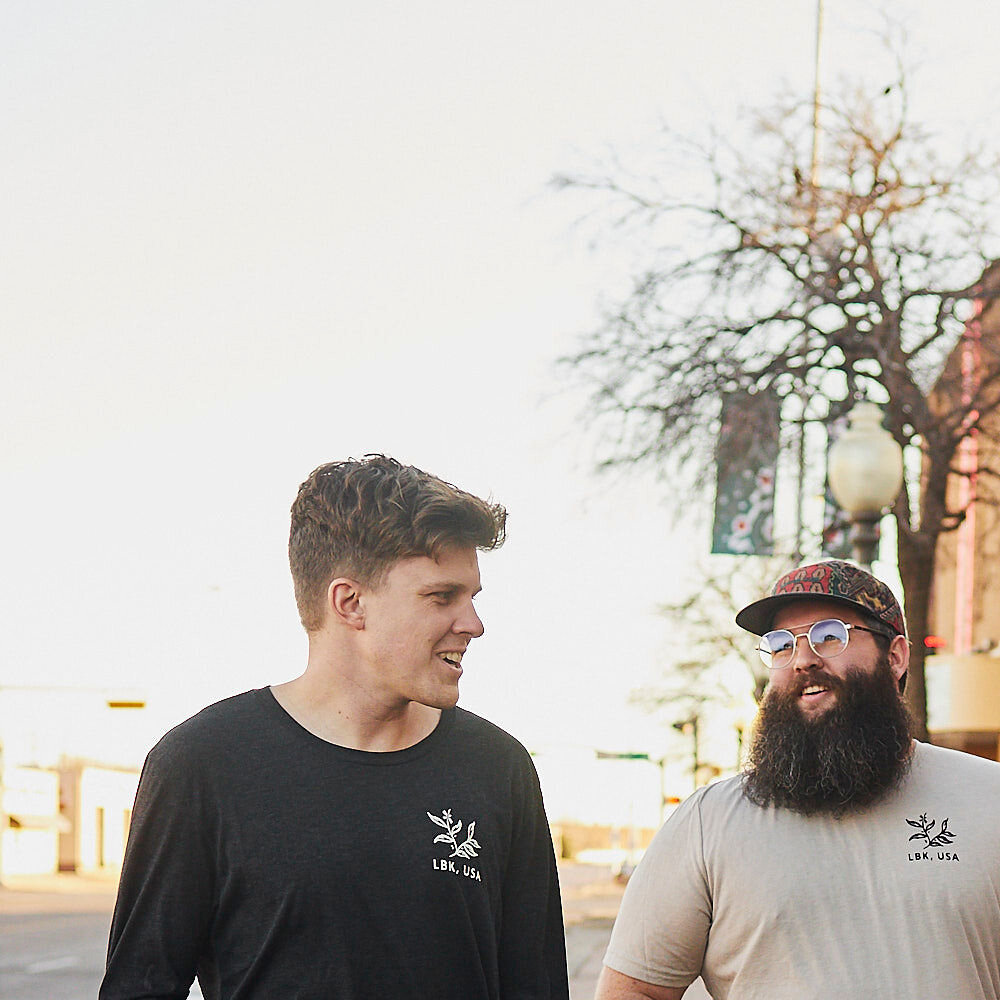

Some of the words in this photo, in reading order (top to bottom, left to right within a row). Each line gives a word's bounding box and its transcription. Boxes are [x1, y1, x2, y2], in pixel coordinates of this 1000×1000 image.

[907, 851, 934, 862] LBK,
[937, 852, 960, 862] USA
[432, 858, 460, 875] LBK,
[463, 864, 482, 882] USA
